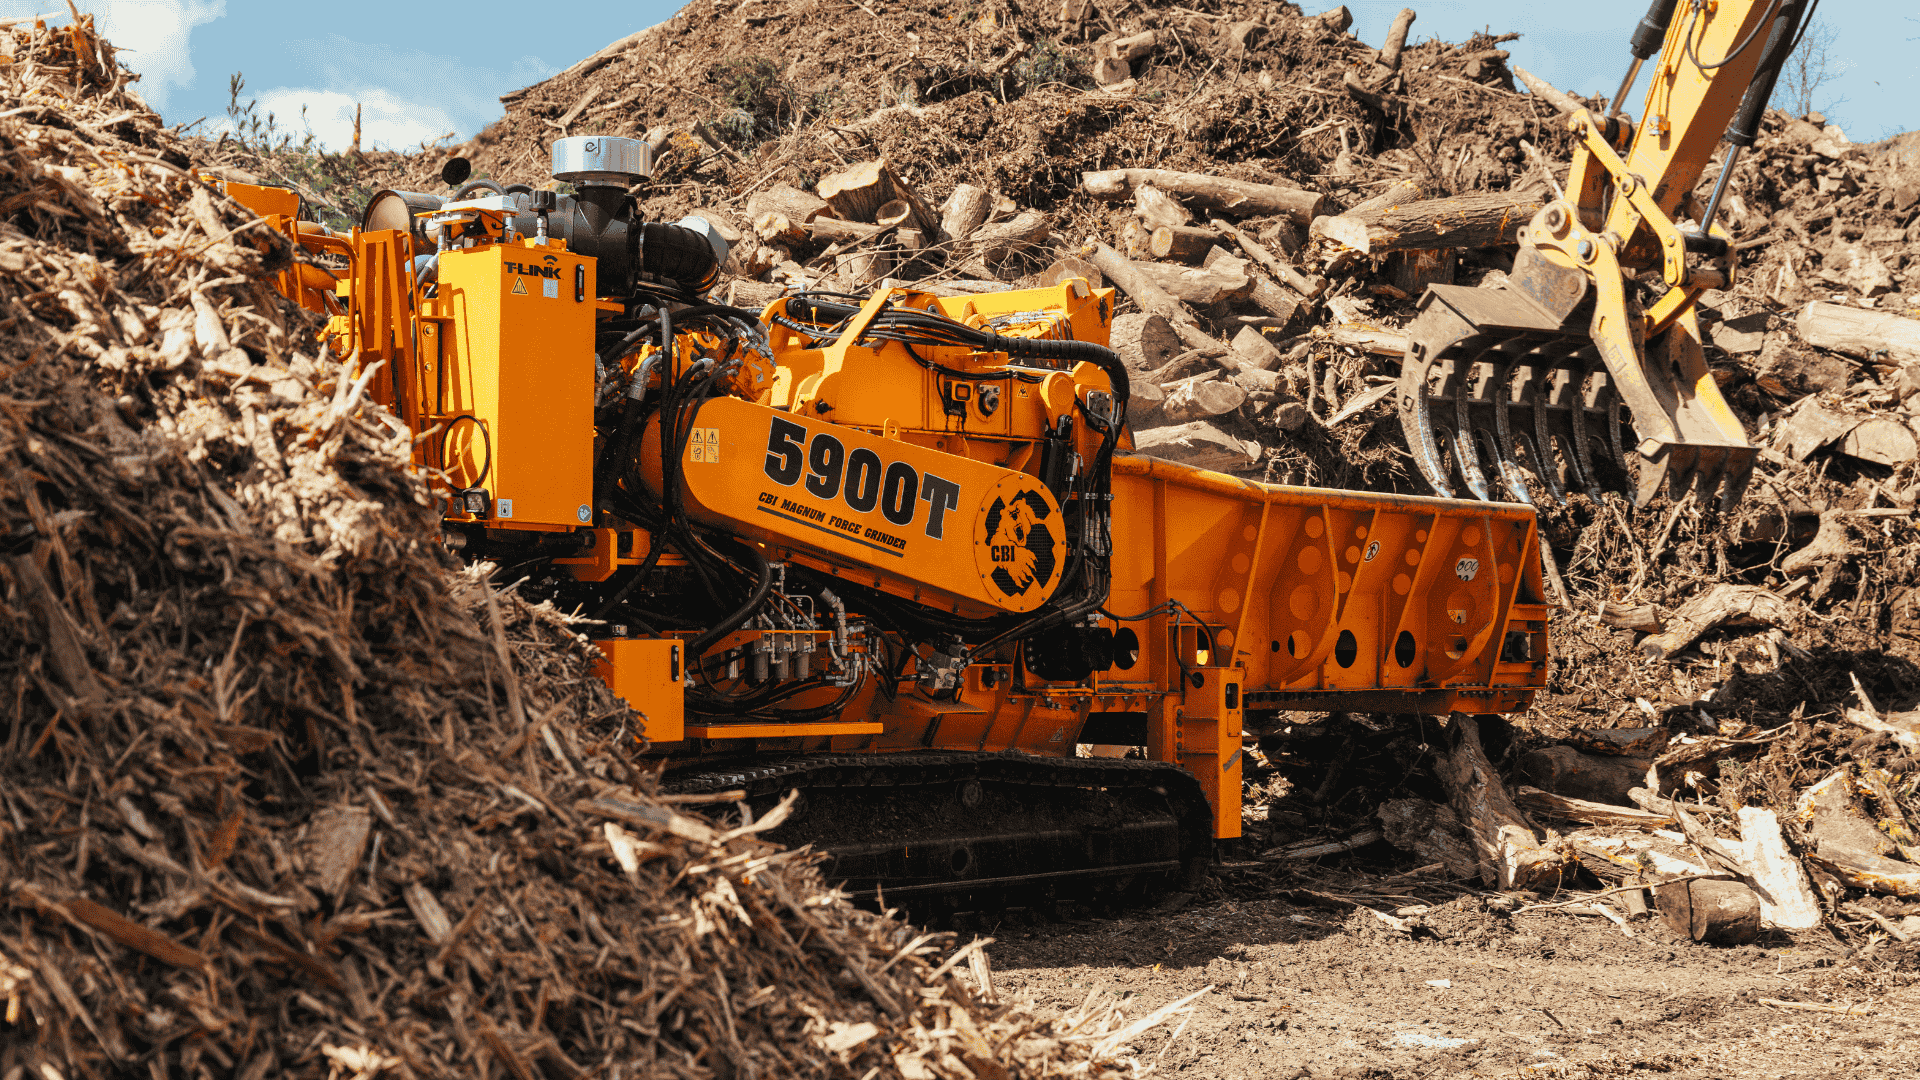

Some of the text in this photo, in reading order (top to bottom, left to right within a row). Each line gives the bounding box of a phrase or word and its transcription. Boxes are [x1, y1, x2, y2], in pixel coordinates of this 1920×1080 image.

[504, 261, 561, 280] T-LINK
[764, 415, 961, 540] 5900T
[758, 492, 907, 550] CBI MAGNUM FORCE GRINDER
[991, 545, 1016, 562] CBI
